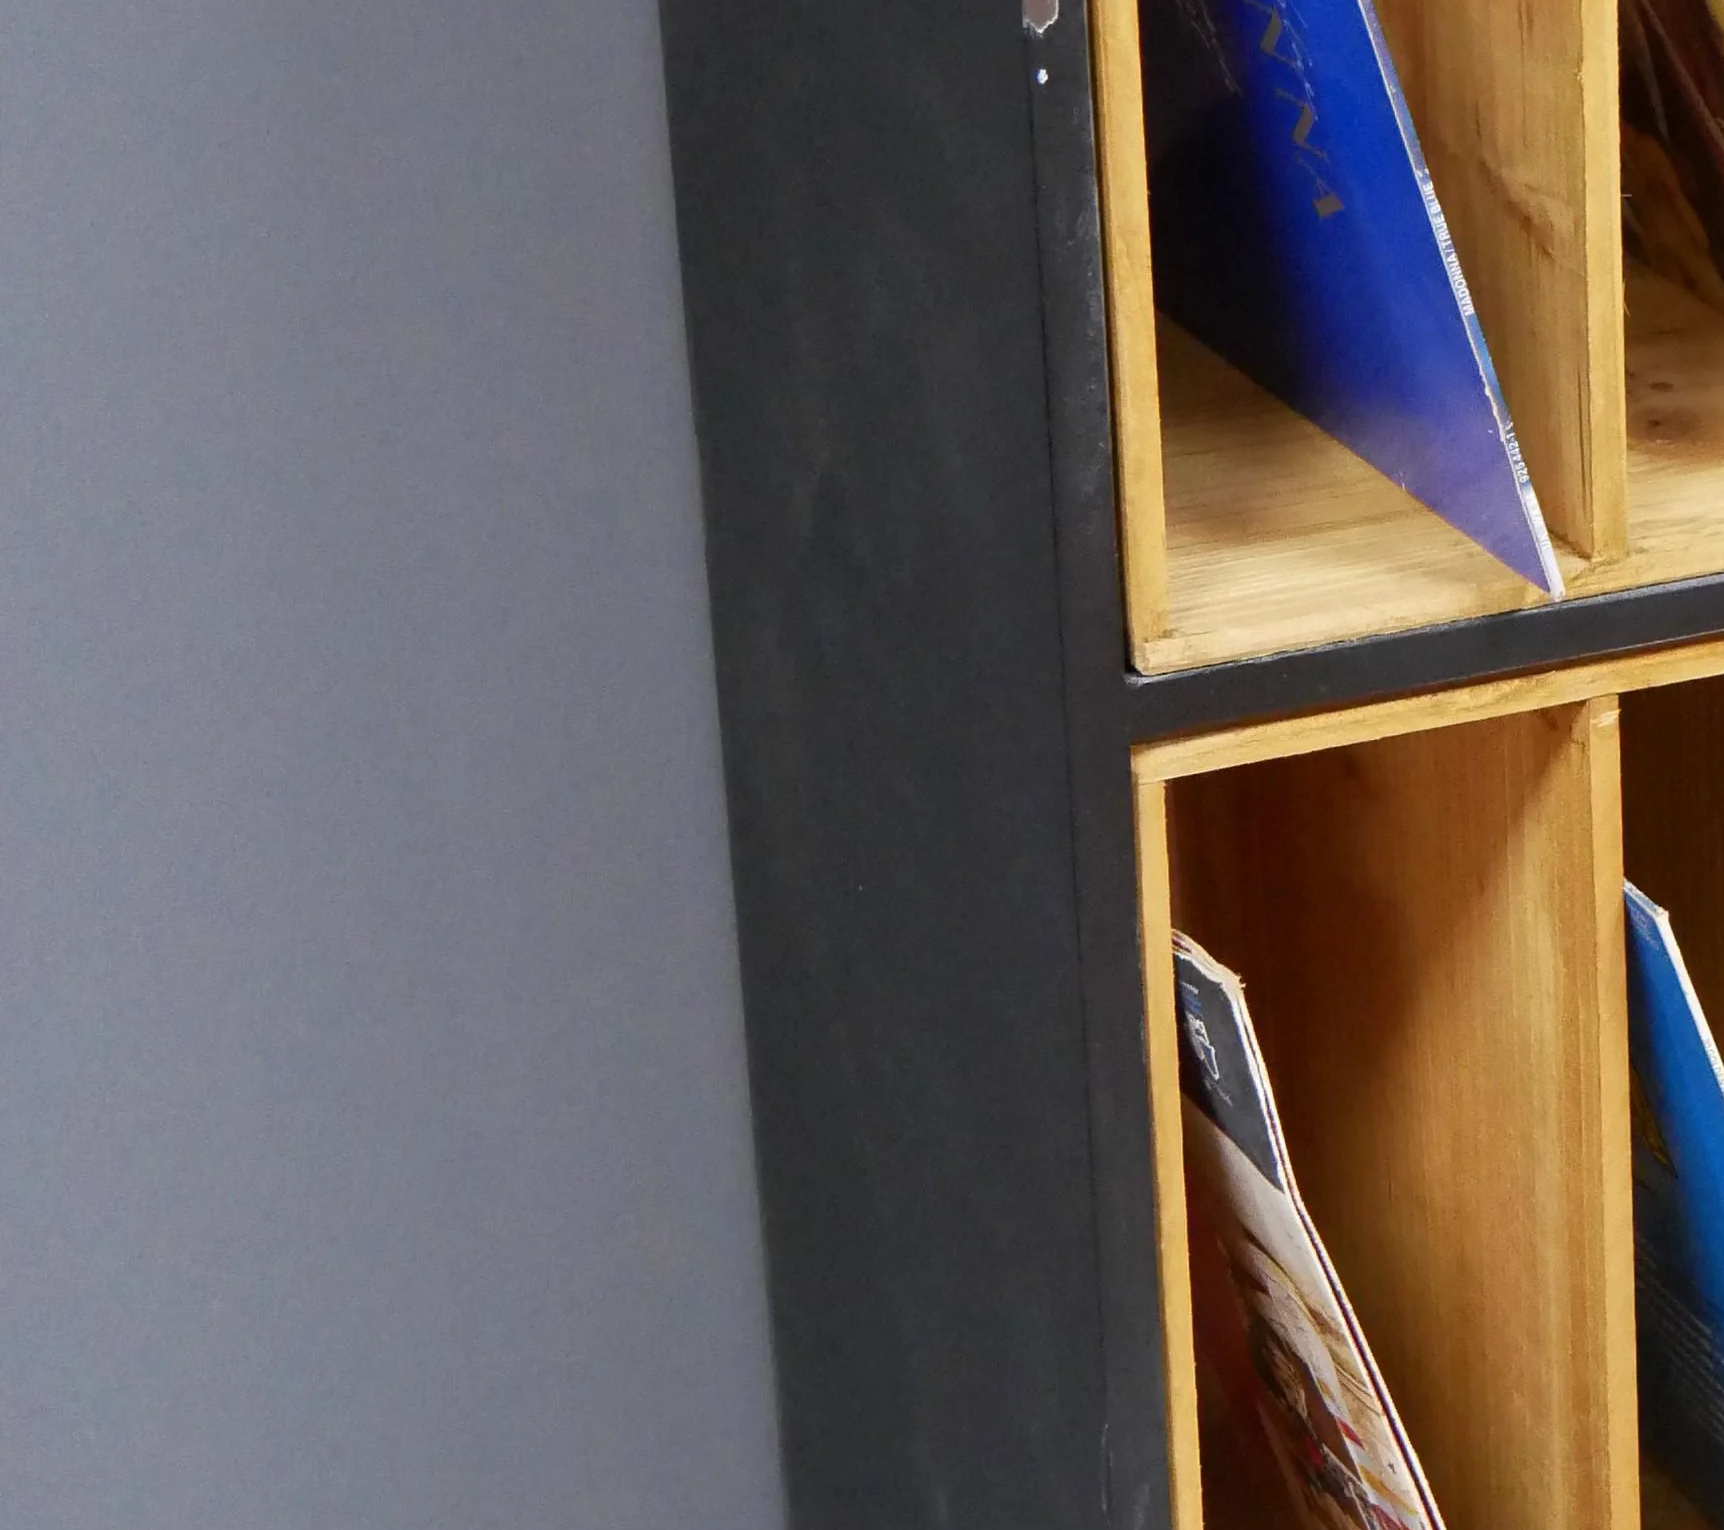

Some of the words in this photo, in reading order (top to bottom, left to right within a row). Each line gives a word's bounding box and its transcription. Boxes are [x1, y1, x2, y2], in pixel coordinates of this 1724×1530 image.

[1420, 180, 1441, 214] BLUE
[1431, 212, 1453, 249] TRUE
[1446, 252, 1475, 317] MADONNA
